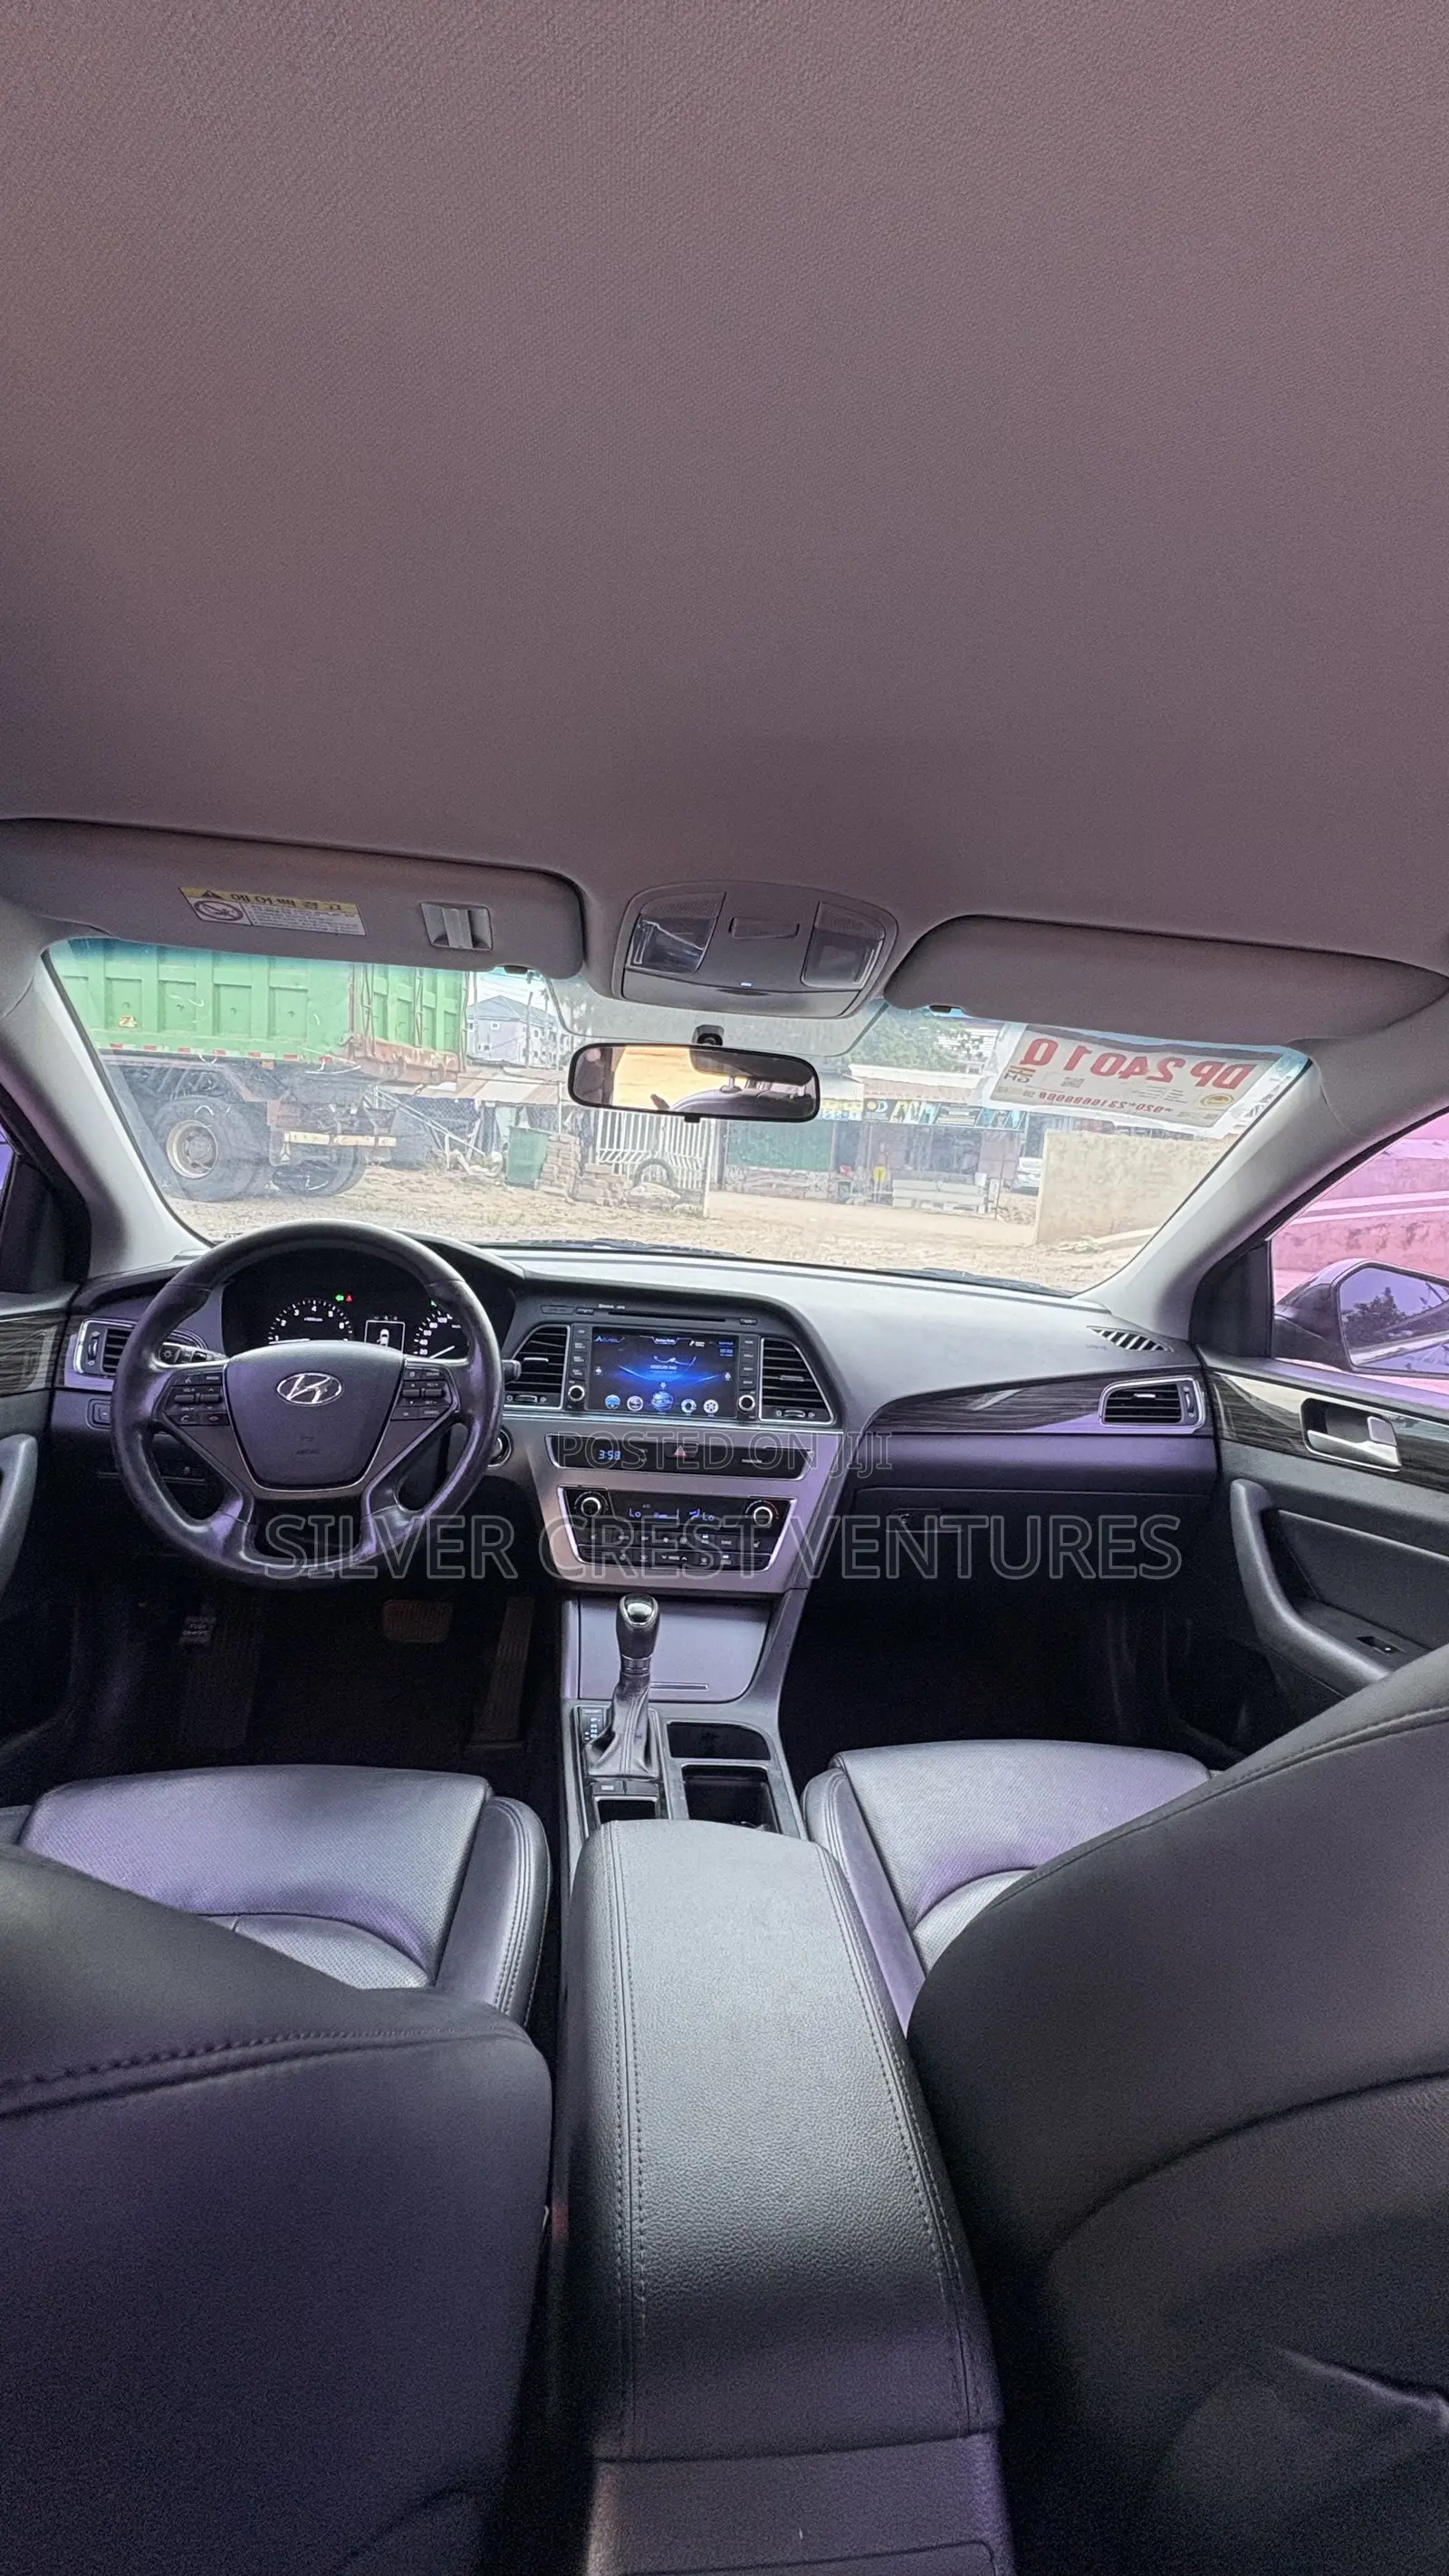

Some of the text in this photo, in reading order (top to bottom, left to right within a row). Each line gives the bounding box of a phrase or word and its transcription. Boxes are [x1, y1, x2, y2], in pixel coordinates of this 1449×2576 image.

[293, 1308, 300, 1317] 3
[599, 1450, 621, 1460] 3:58
[629, 1508, 641, 1518] Lo
[702, 1511, 715, 1522] Lo
